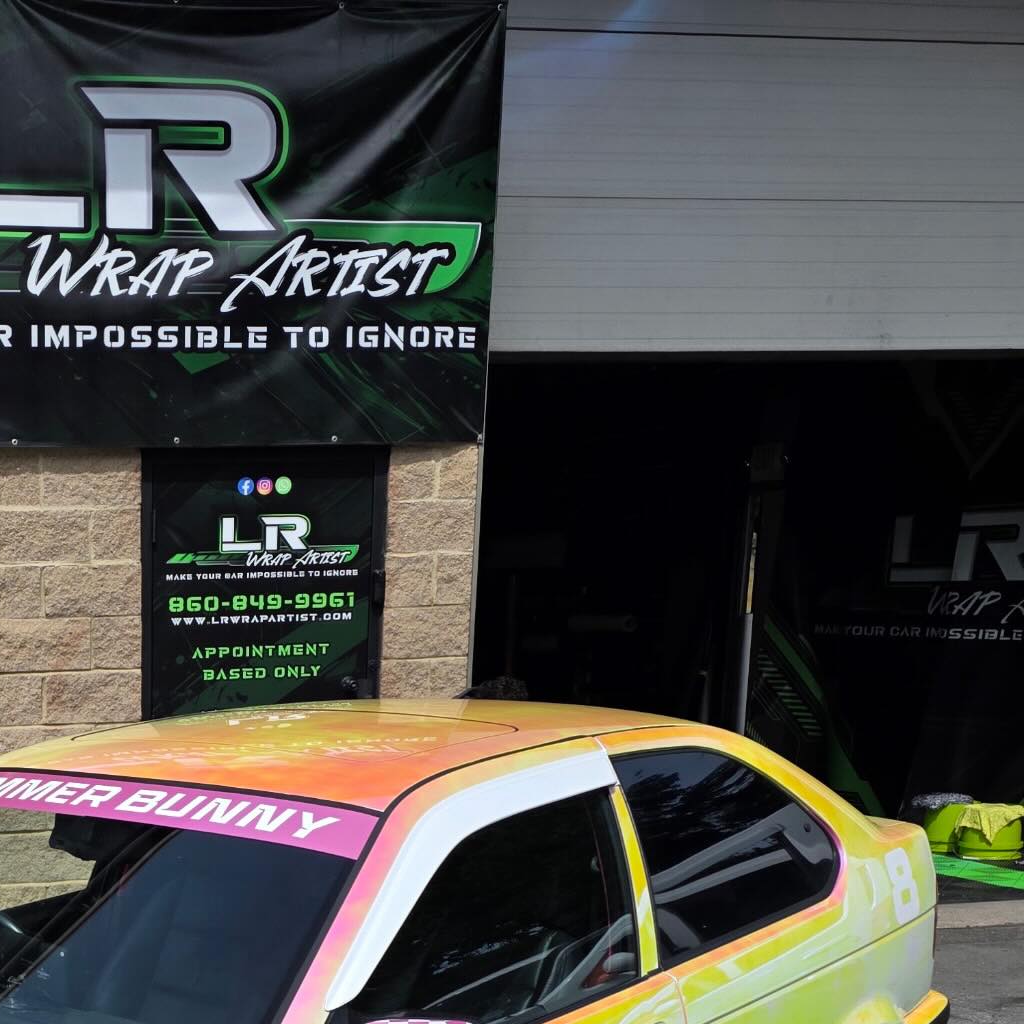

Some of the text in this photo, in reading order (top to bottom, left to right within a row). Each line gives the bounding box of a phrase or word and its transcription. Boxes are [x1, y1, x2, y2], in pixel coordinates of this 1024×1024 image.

[26, 236, 450, 311] WRAP ARTIST
[30, 323, 268, 350] IMPOSSIBLE
[283, 325, 330, 350] TO
[345, 324, 477, 350] IGNORE
[221, 516, 310, 551] LR
[245, 549, 352, 569] WRAP ARTIST
[166, 573, 193, 581] MAKE
[195, 572, 222, 581] YOUR
[246, 570, 305, 579] IMPOSSIBLE
[307, 570, 321, 578] TO
[323, 569, 359, 577] IGNORE
[168, 591, 355, 613] 860-849-9961
[170, 612, 353, 626] WWW.LRWRAPARTIST.COM
[192, 643, 330, 659] APPOINTMENT
[203, 665, 321, 681] BASED ONLY
[114, 789, 341, 839] BUNNY
[885, 847, 921, 925] 8
